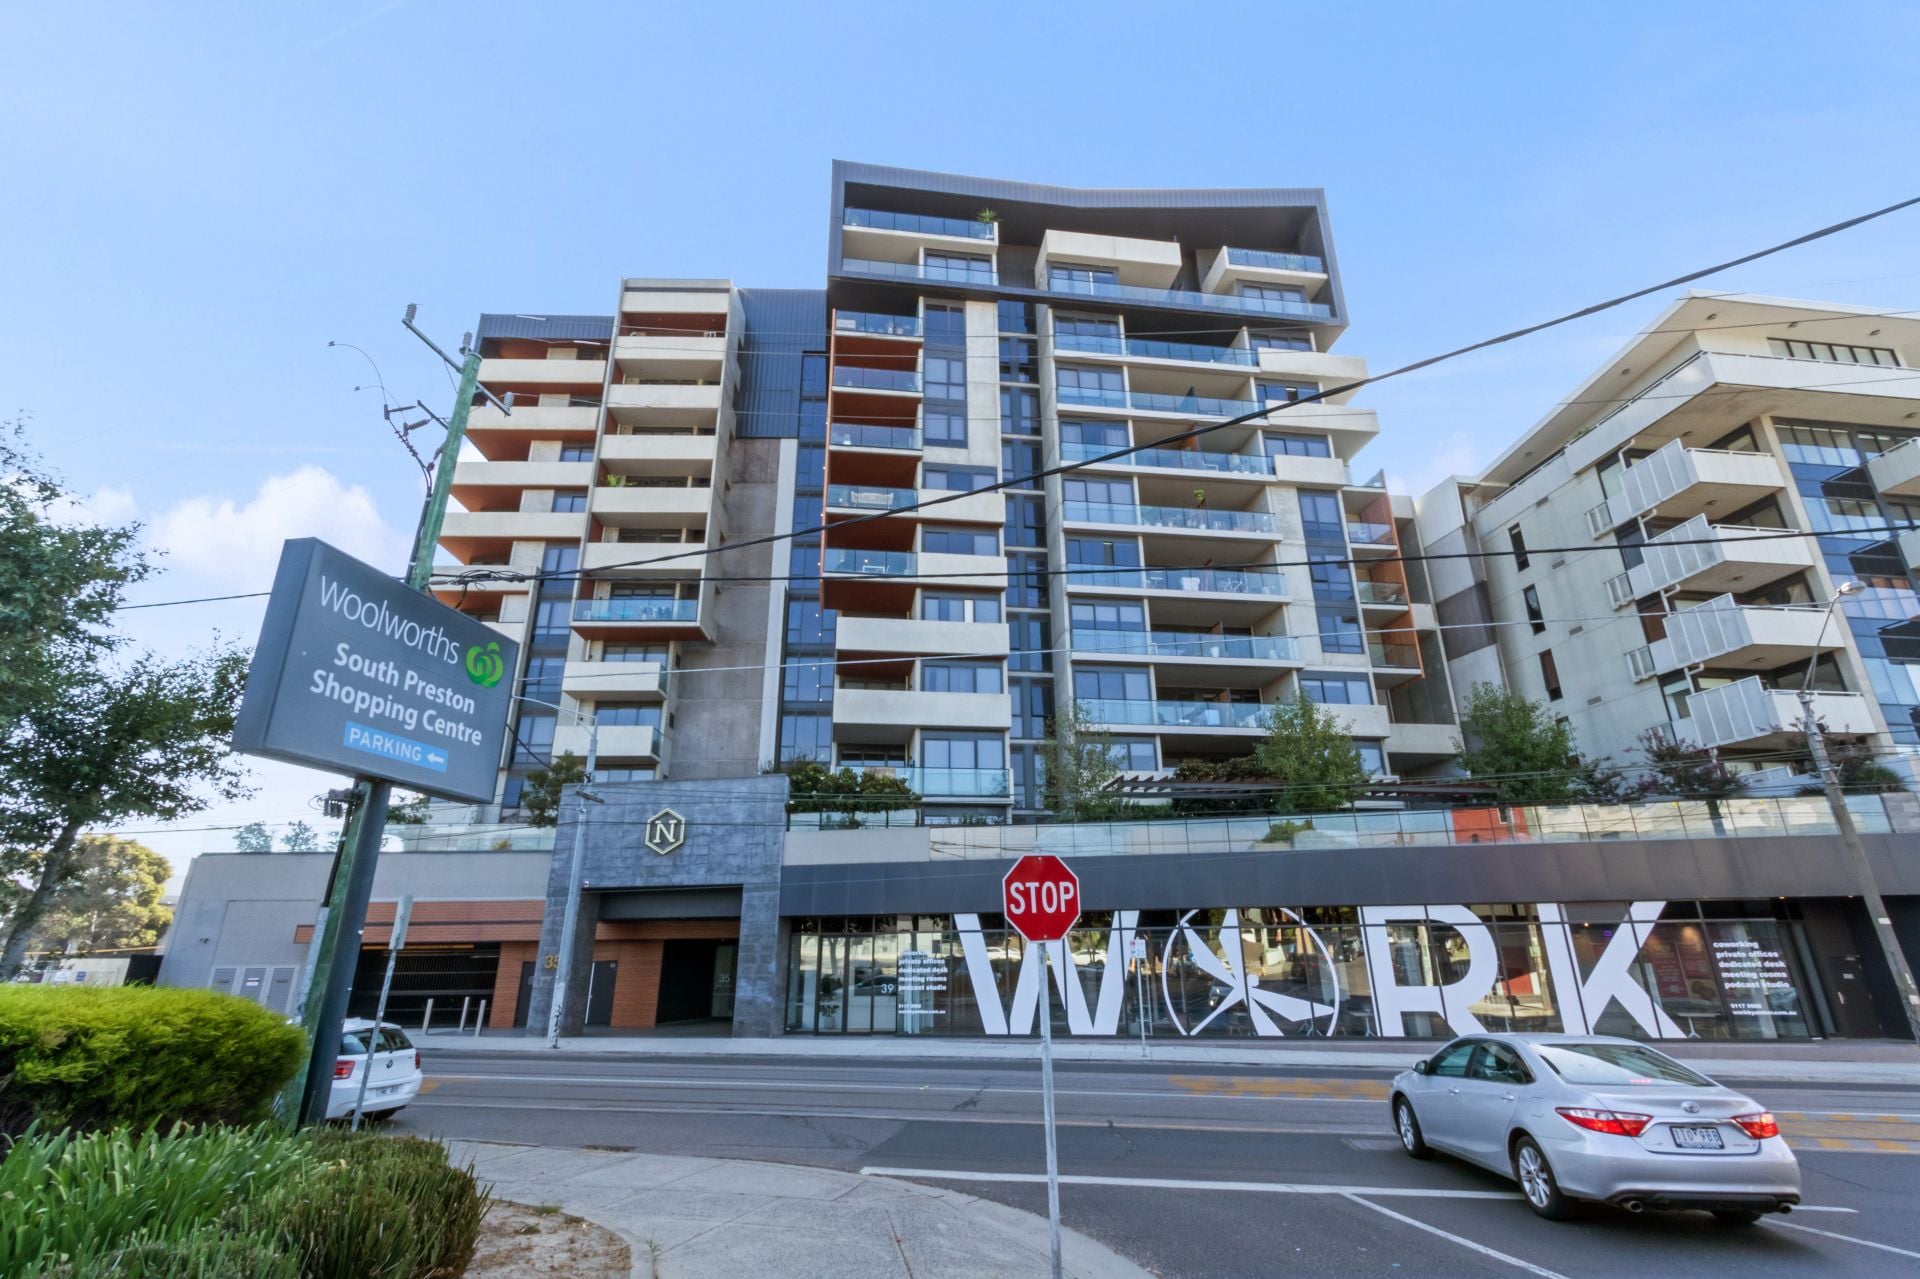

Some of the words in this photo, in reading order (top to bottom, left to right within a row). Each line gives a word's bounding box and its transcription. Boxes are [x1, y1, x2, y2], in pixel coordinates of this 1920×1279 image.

[321, 575, 460, 665] Woolworths
[333, 642, 400, 686] South
[403, 669, 475, 714] Preston
[309, 669, 419, 730] Shopping
[422, 710, 482, 745] Centre
[349, 728, 422, 761] PARKING
[653, 820, 678, 843] N
[1009, 881, 1075, 915] STOP
[1716, 951, 1747, 959] private
[1718, 960, 1762, 968] dedicated
[1763, 960, 1786, 968] desk
[881, 983, 894, 994] 39
[1724, 981, 1760, 990] podcast
